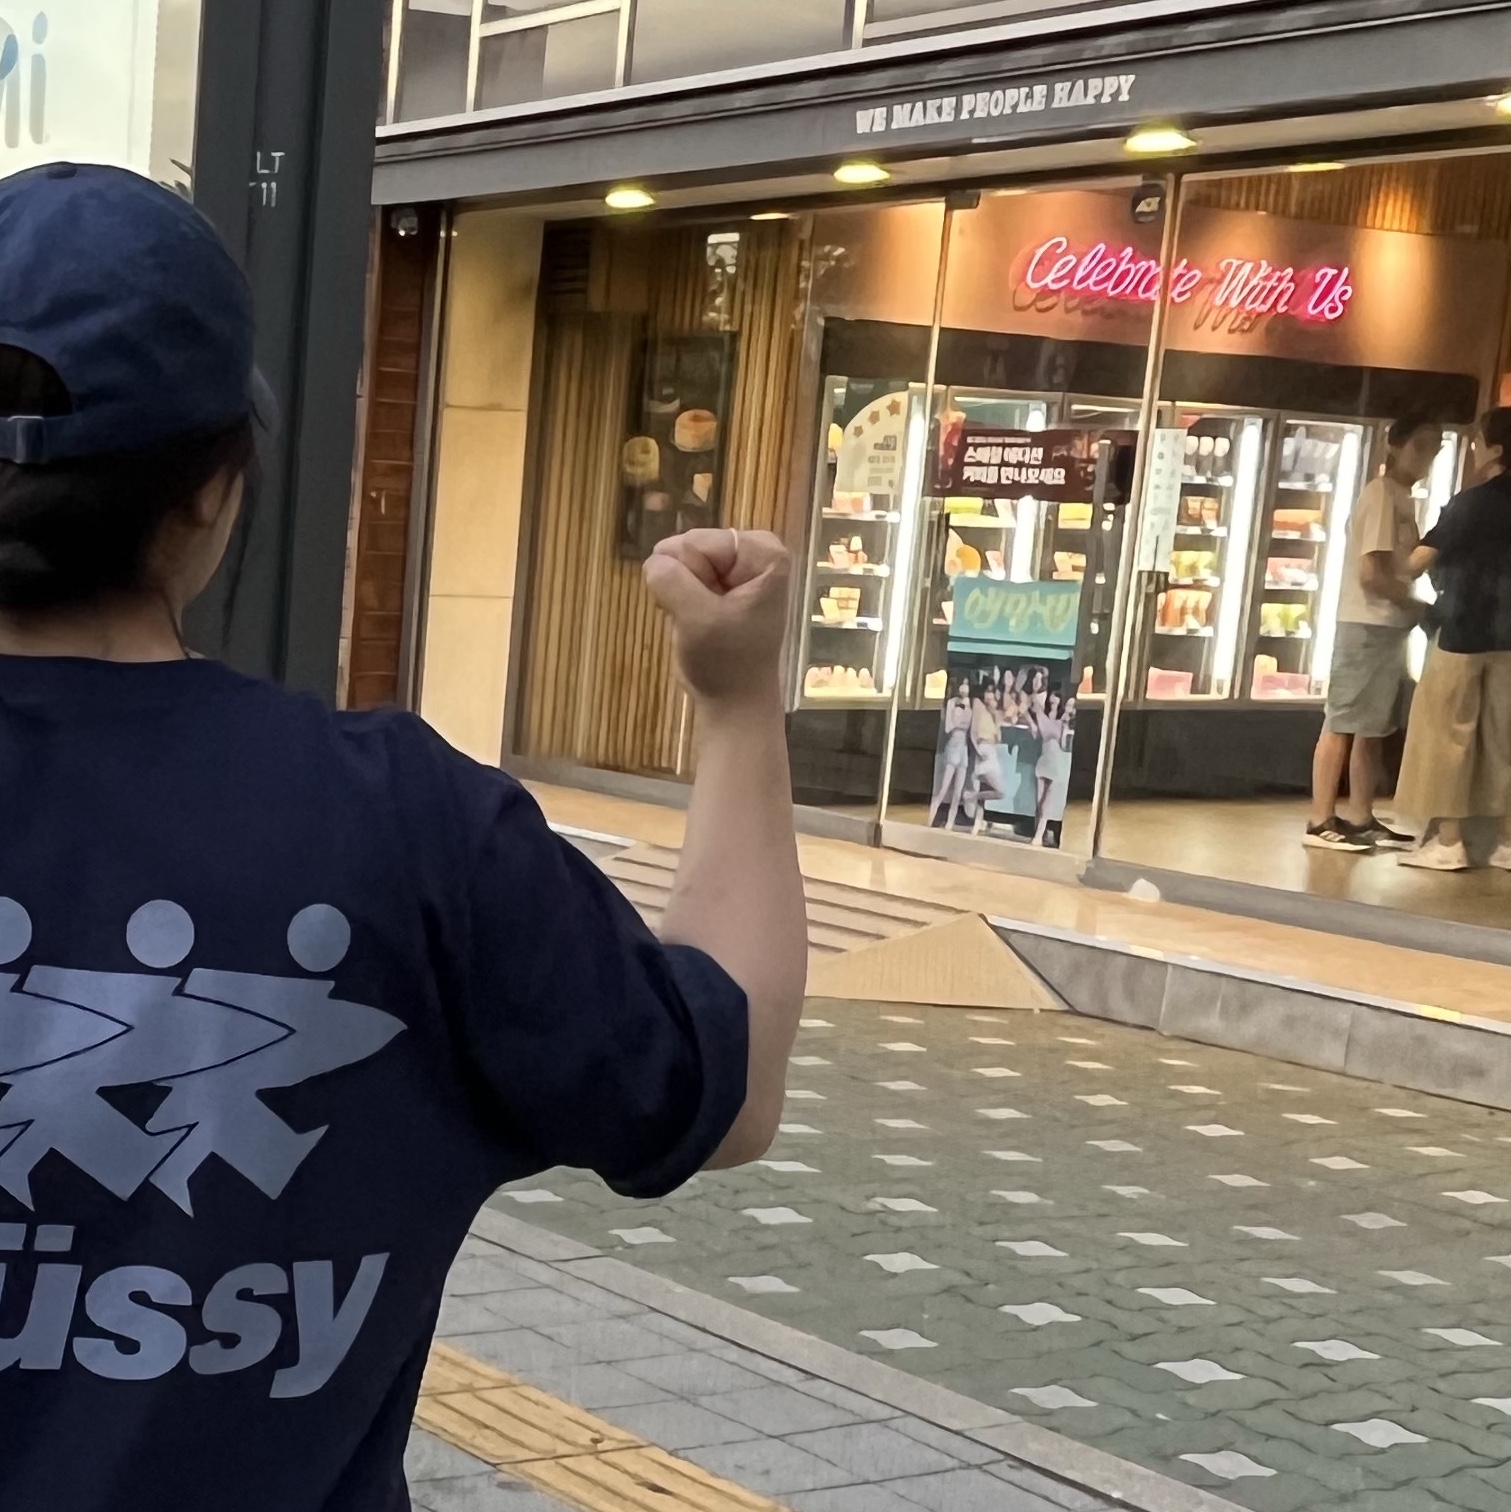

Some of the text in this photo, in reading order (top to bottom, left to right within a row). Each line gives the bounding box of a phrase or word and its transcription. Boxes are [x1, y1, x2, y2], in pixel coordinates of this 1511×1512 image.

[856, 74, 1137, 134] WE MAKE PEOPLE HAPPY
[256, 151, 286, 174] LT
[1025, 236, 1353, 320] Celebrate With Us
